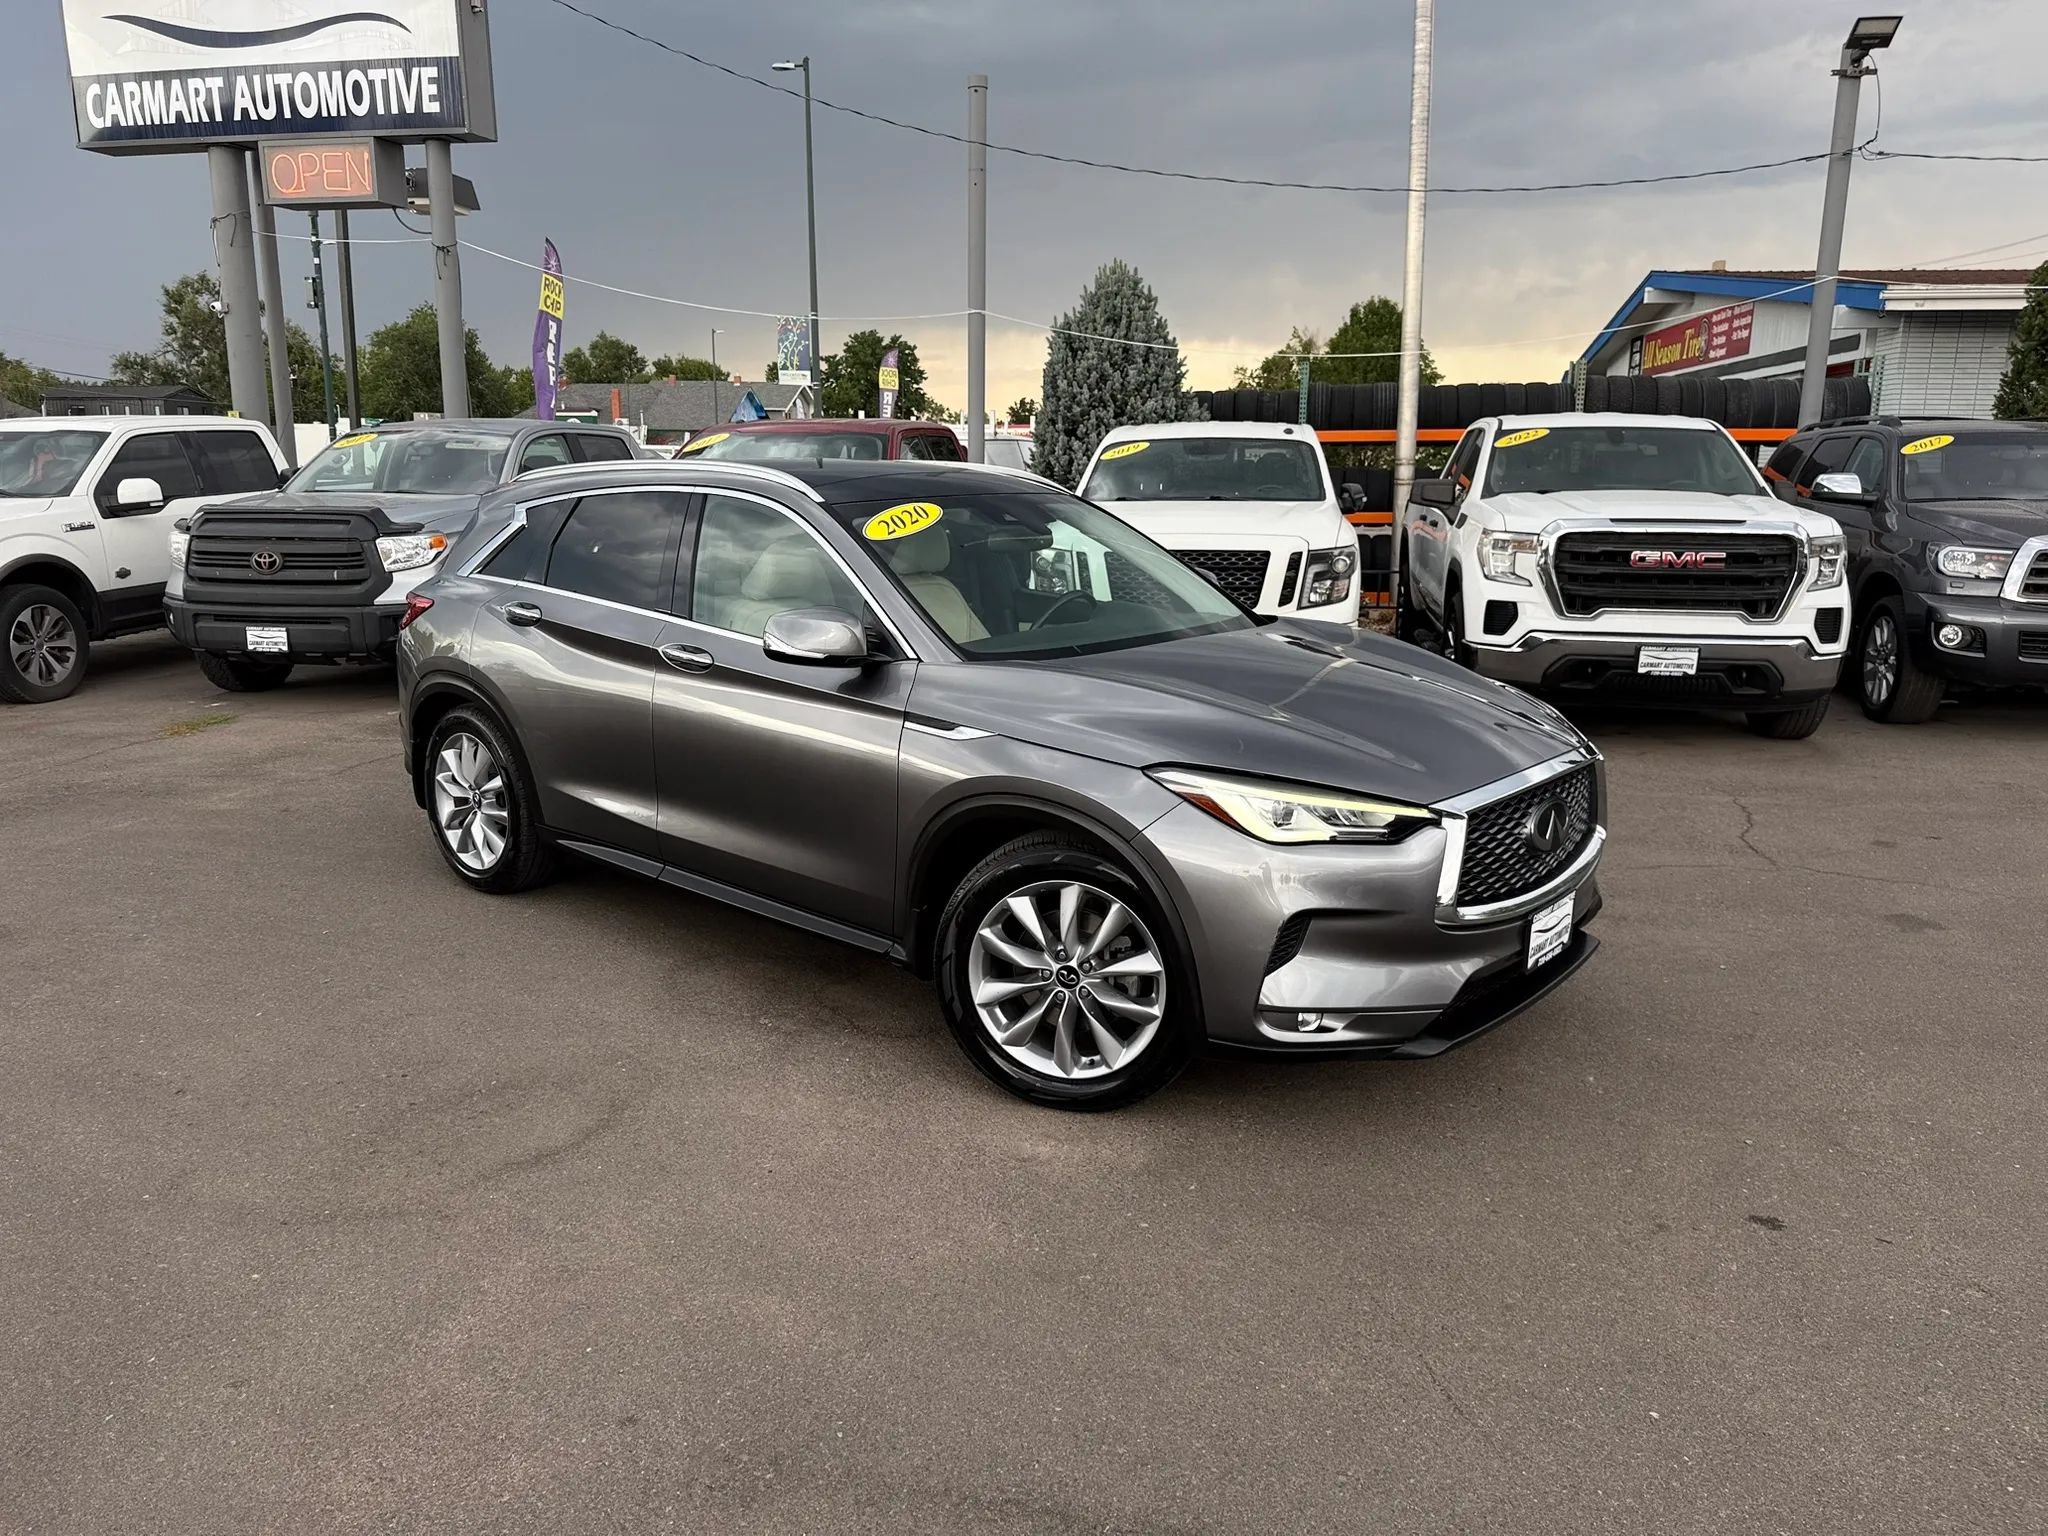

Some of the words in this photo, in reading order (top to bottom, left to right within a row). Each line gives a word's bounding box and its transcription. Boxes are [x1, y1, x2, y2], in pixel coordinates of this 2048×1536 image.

[86, 75, 224, 129] CARMART
[233, 66, 441, 121] AUTOMOTIVE
[271, 151, 371, 194] OPEN
[1654, 338, 1682, 366] Season
[1505, 430, 1539, 445] 2022
[1911, 437, 1942, 452] 2017
[1109, 444, 1140, 457] 2019
[878, 505, 929, 535] 2020
[1630, 550, 1727, 569] GMC
[1640, 661, 1664, 669] CARMART
[1663, 662, 1695, 671] AUTOMOTIVE
